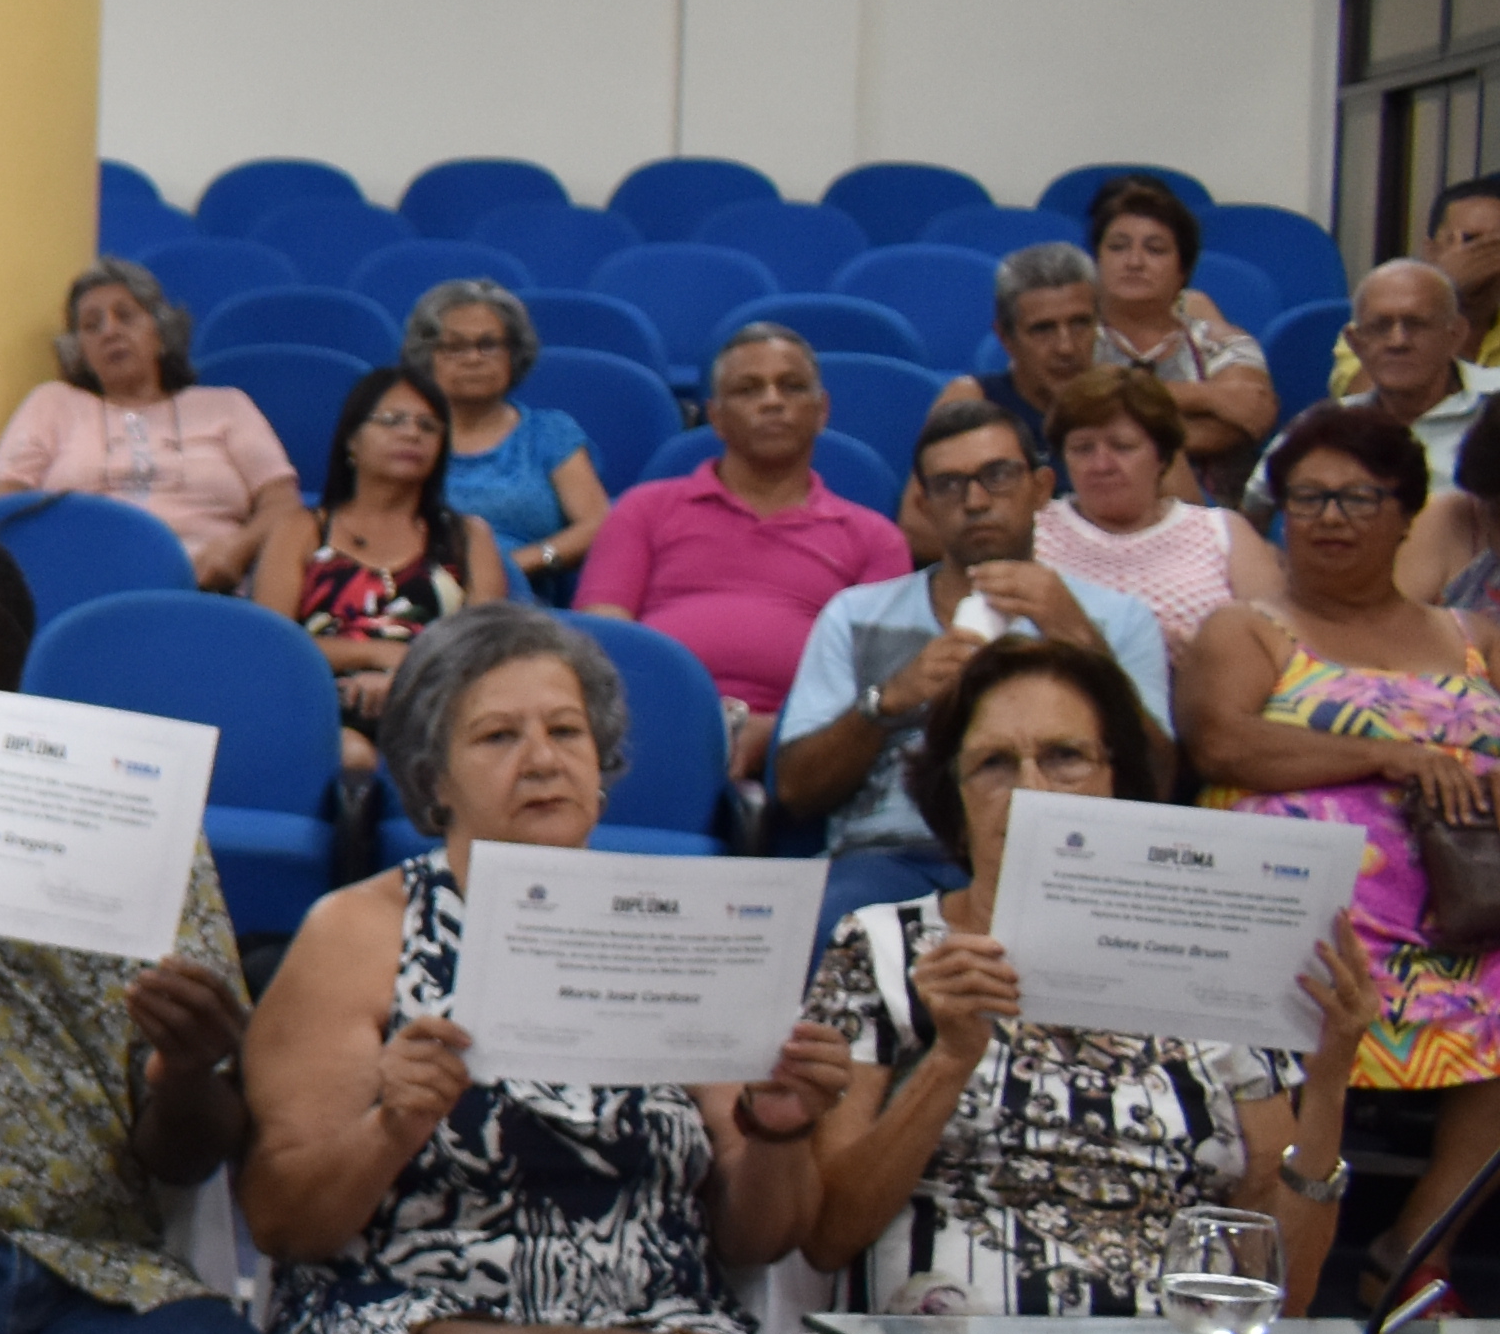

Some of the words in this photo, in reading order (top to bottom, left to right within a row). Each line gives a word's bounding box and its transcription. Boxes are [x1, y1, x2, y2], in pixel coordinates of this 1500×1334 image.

[4, 736, 67, 761] DIPLOMA
[1148, 847, 1214, 869] DIPLOMA
[613, 898, 679, 915] DIPLOMA
[558, 987, 600, 1001] Maria
